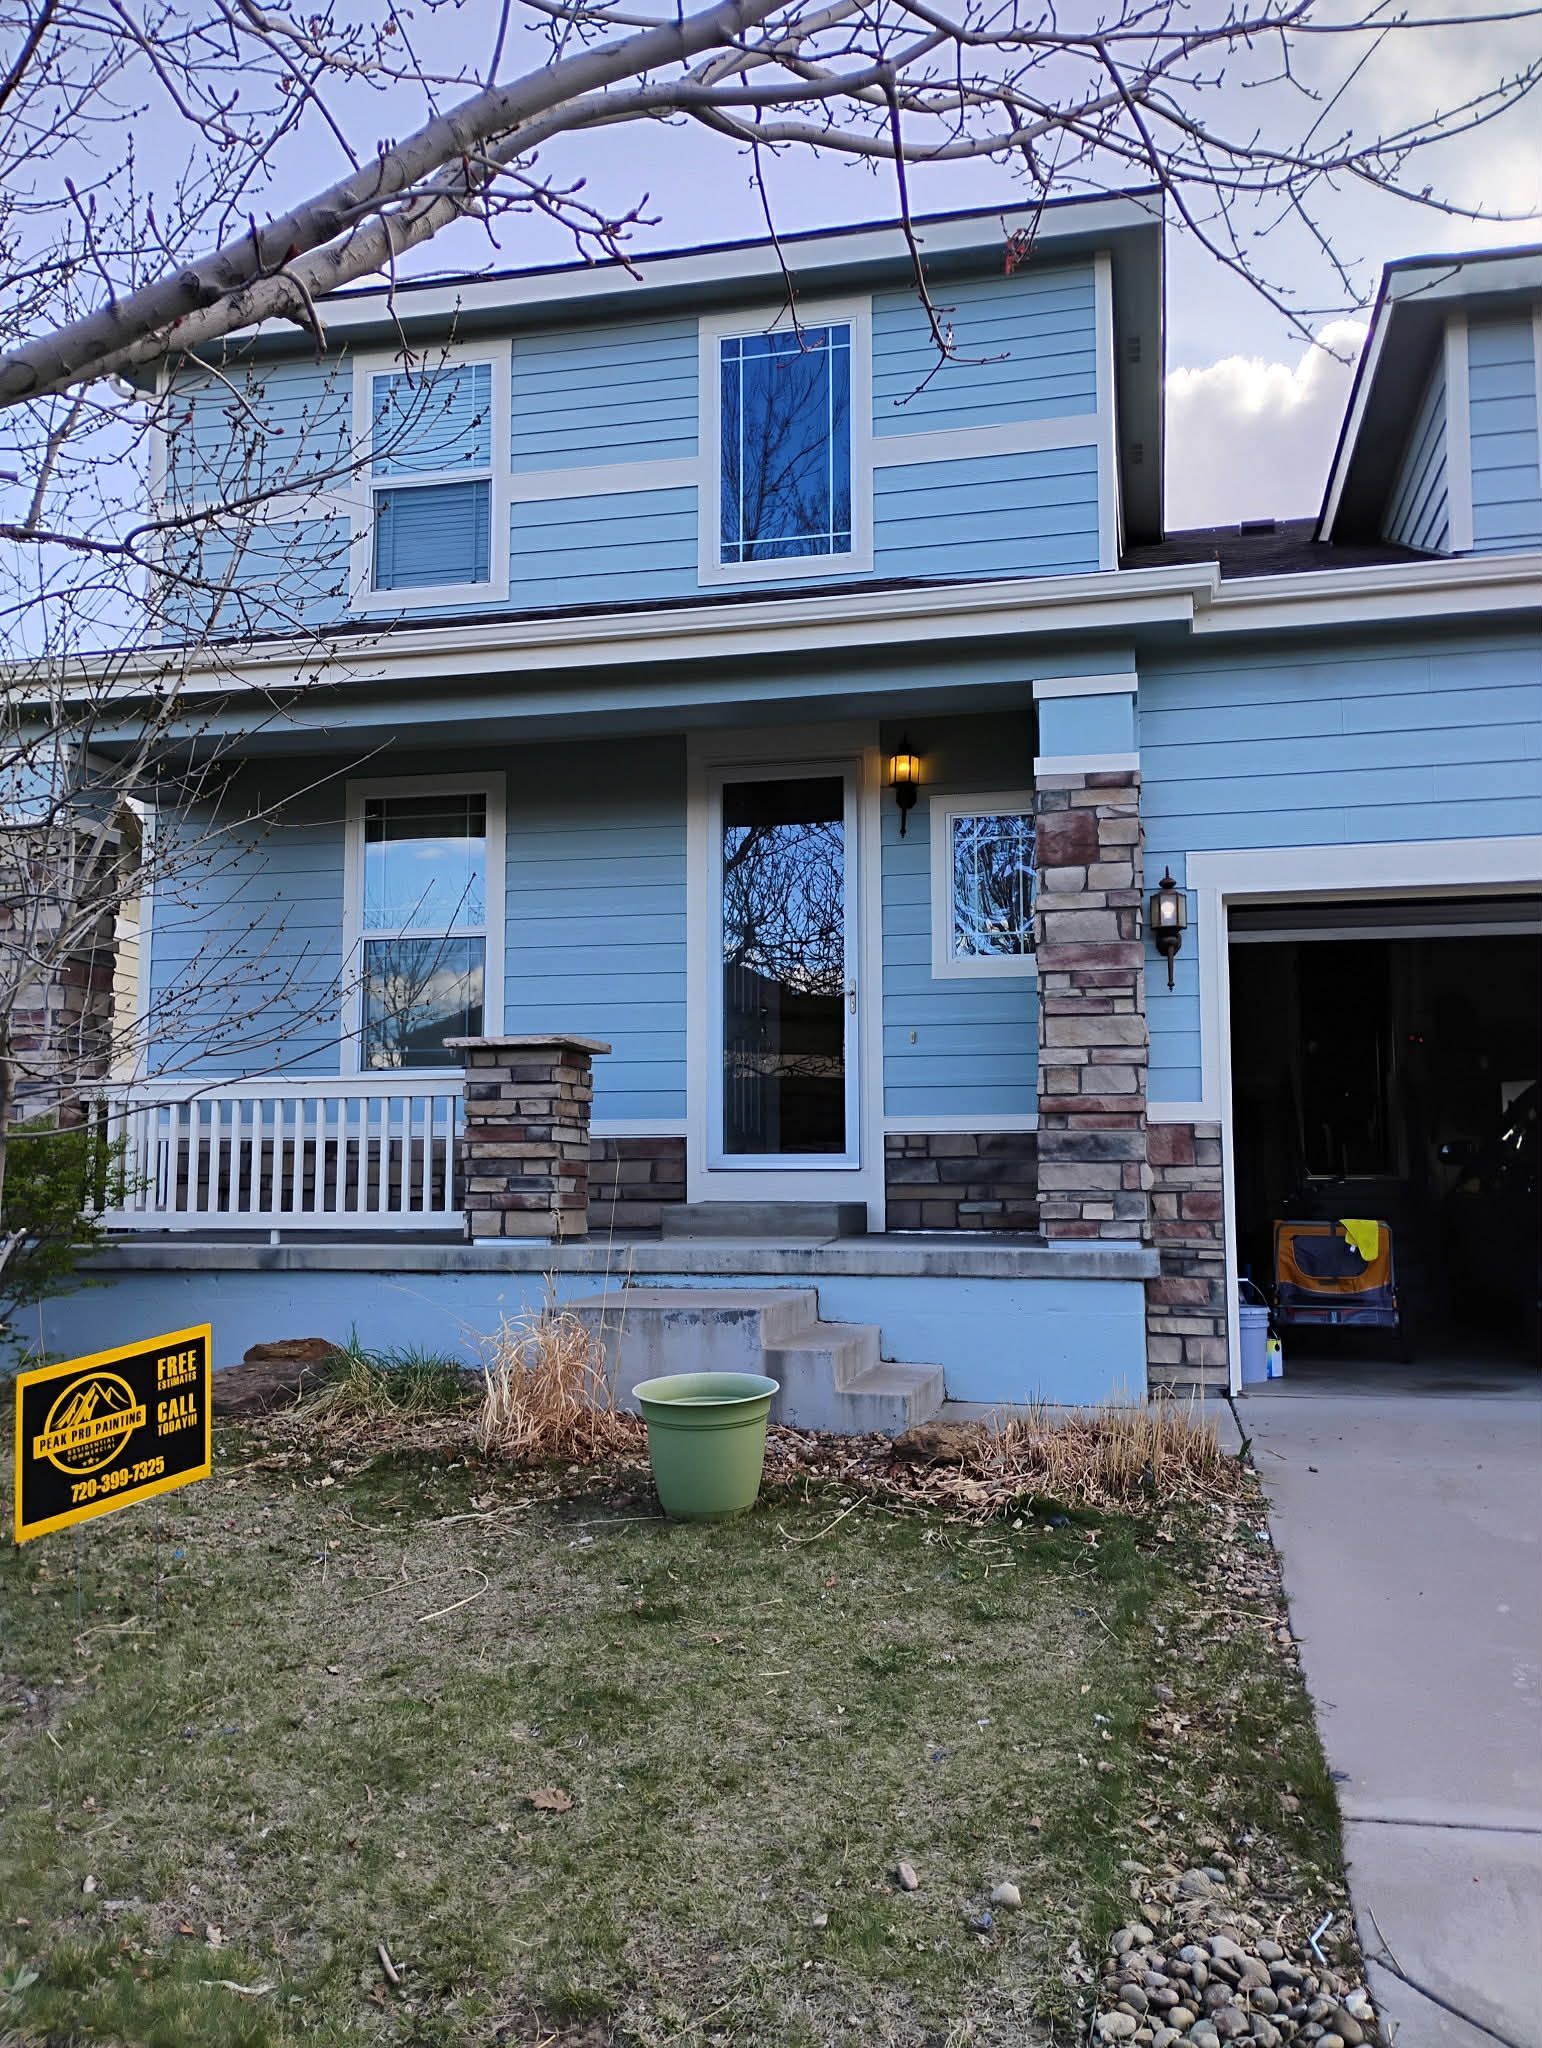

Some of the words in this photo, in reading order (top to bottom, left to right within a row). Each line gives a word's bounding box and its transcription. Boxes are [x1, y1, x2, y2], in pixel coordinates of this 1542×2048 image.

[157, 1349, 197, 1381] FREE
[157, 1371, 197, 1392] ESTIMATES
[157, 1392, 197, 1423] CALL
[40, 1433, 67, 1452] PEAK
[71, 1426, 91, 1443] PRO
[95, 1411, 142, 1435] PAINTING
[67, 1444, 116, 1463] COMMERCIAL
[71, 1456, 165, 1504] 720-399-7325
